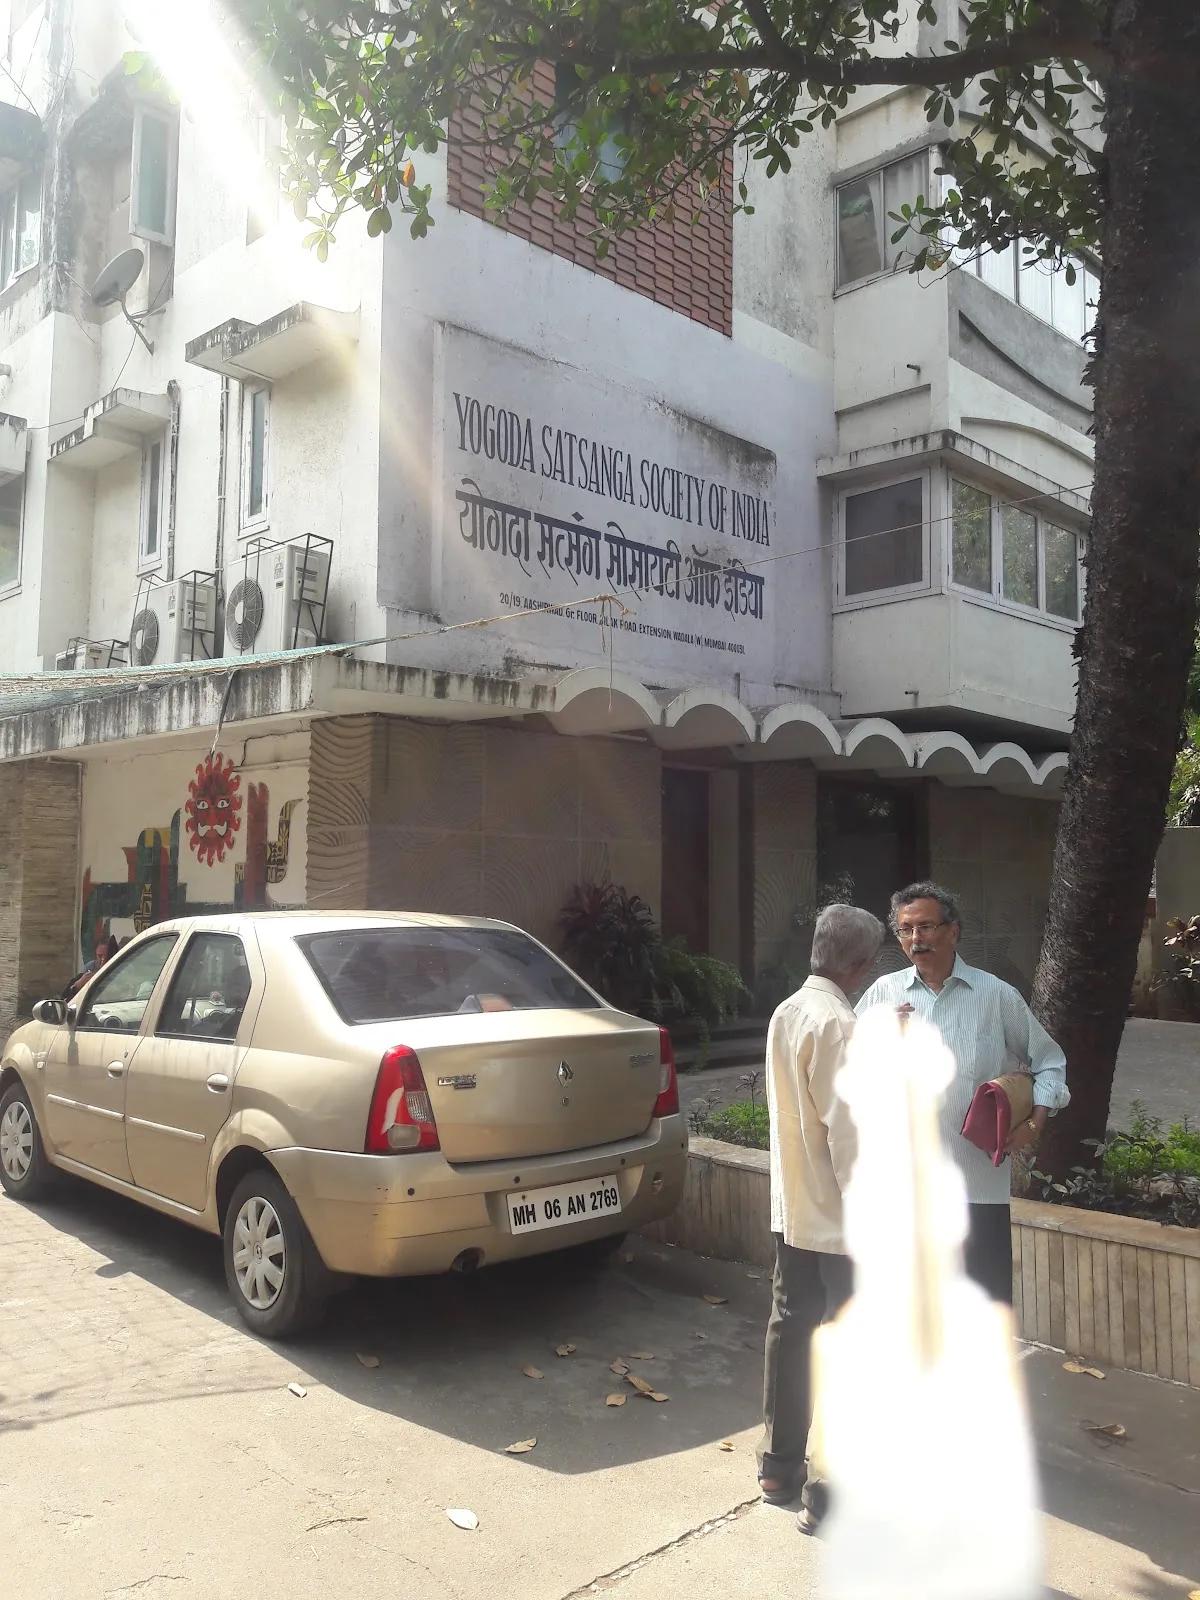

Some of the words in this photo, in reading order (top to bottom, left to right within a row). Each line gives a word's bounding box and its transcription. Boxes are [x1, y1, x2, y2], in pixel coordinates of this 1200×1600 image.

[453, 392, 536, 474] YOGODA
[541, 425, 635, 506] SATSANGA
[640, 459, 706, 526] SOCIETY
[708, 483, 728, 534] OF
[731, 489, 770, 547] INDIA
[455, 477, 532, 578] योगदा
[533, 511, 602, 586] सत्संग
[604, 521, 682, 602] सोसायटी
[684, 544, 722, 609] ऑफ
[723, 558, 765, 622] इंडिया
[704, 637, 727, 651] MUMBAI
[512, 1203, 537, 1227] MH
[543, 1198, 562, 1220] 06
[567, 1194, 586, 1216] AN
[590, 1187, 618, 1211] 2769
